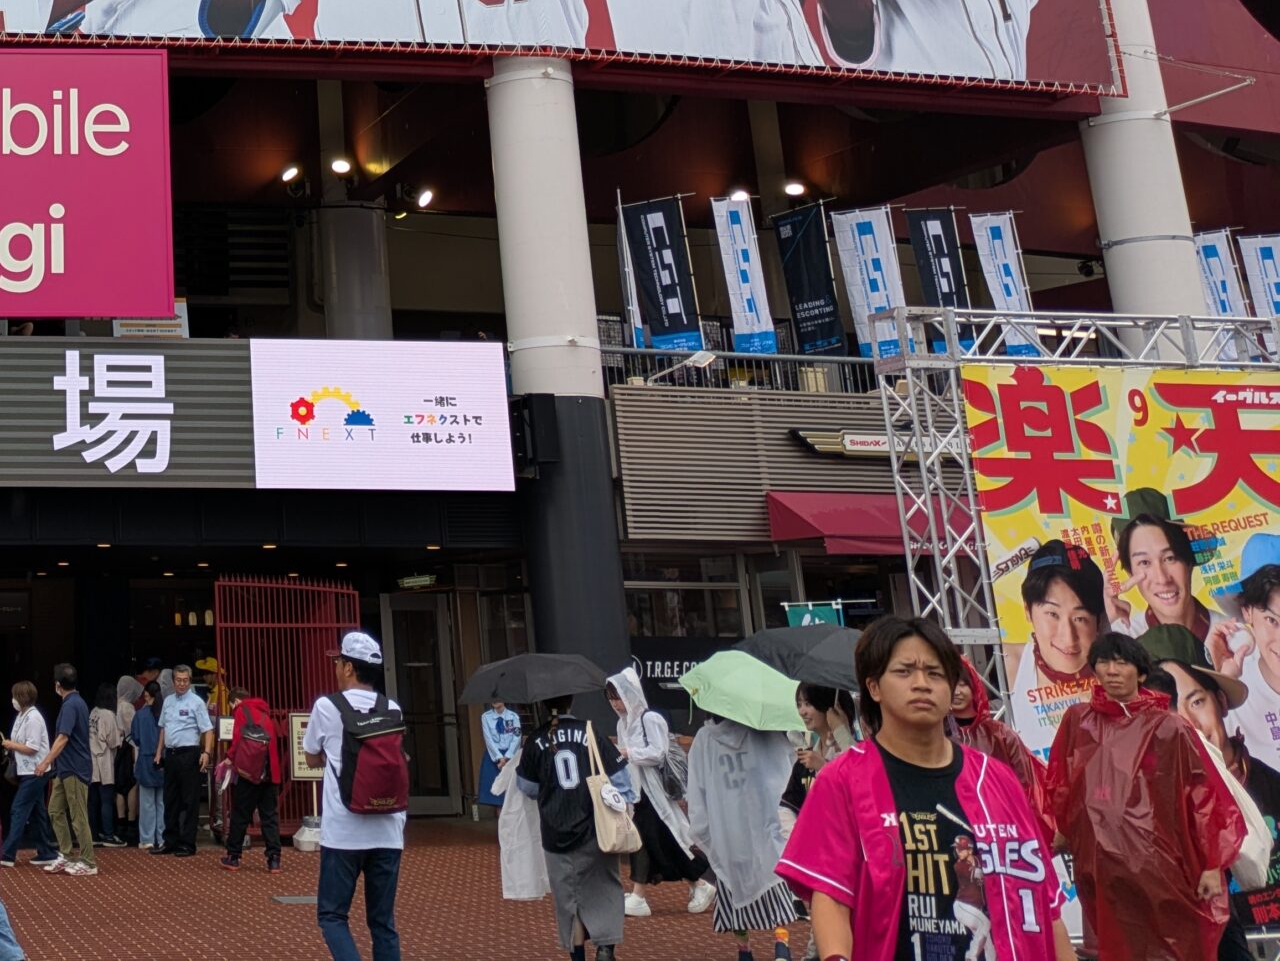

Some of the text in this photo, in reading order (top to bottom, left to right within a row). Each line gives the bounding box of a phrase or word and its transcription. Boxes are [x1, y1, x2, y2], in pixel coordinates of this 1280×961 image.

[796, 305, 834, 319] ESCORTING
[423, 395, 457, 407] 一緒に
[1127, 388, 1149, 427] 9
[403, 414, 483, 426] エフネクストで
[849, 439, 882, 447] SHIDAX
[1183, 512, 1269, 541] THE REQUEST
[1027, 680, 1078, 703] STRIKE
[554, 750, 580, 790] 0
[899, 812, 939, 851] 1ST
[906, 853, 950, 895] HIT
[907, 895, 937, 918] RUI
[1019, 889, 1040, 933] 1
[909, 918, 967, 935] MUNEYAMA
